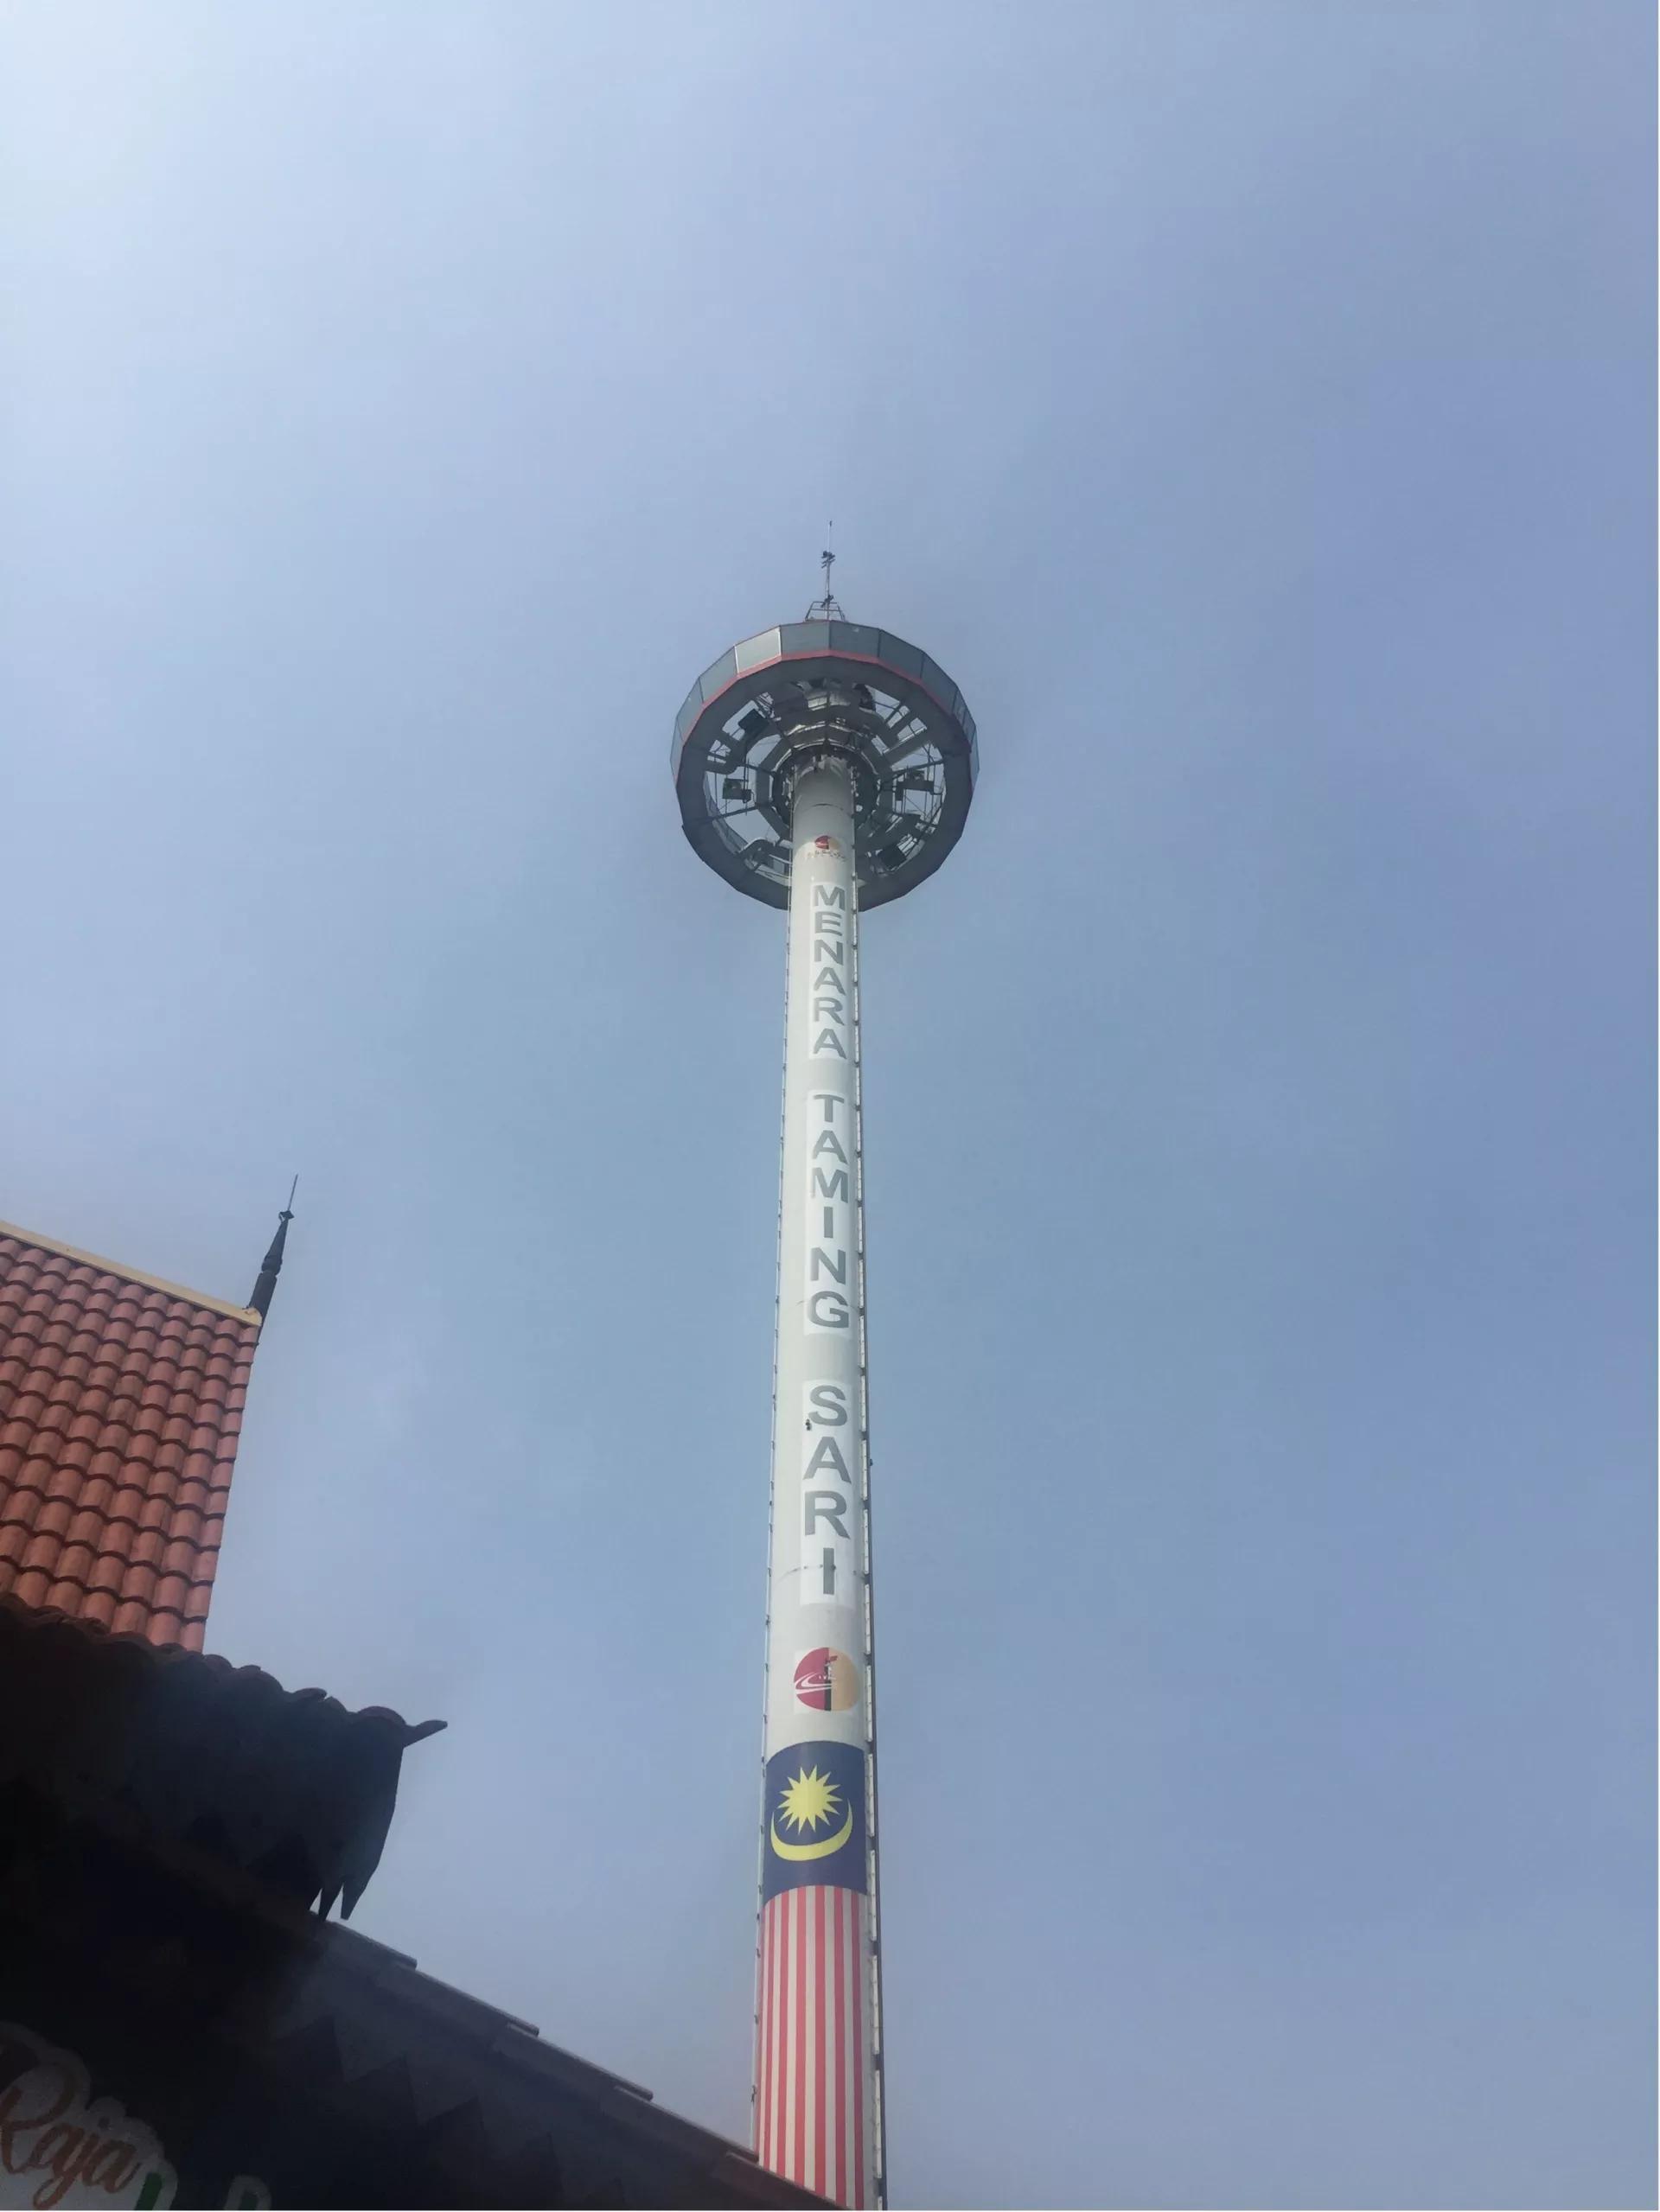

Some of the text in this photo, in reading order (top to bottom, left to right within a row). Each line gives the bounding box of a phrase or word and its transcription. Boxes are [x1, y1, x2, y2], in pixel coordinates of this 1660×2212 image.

[813, 884, 846, 1059] MENARA
[809, 1093, 849, 1329] TAMING
[803, 1385, 852, 1596] SARI
